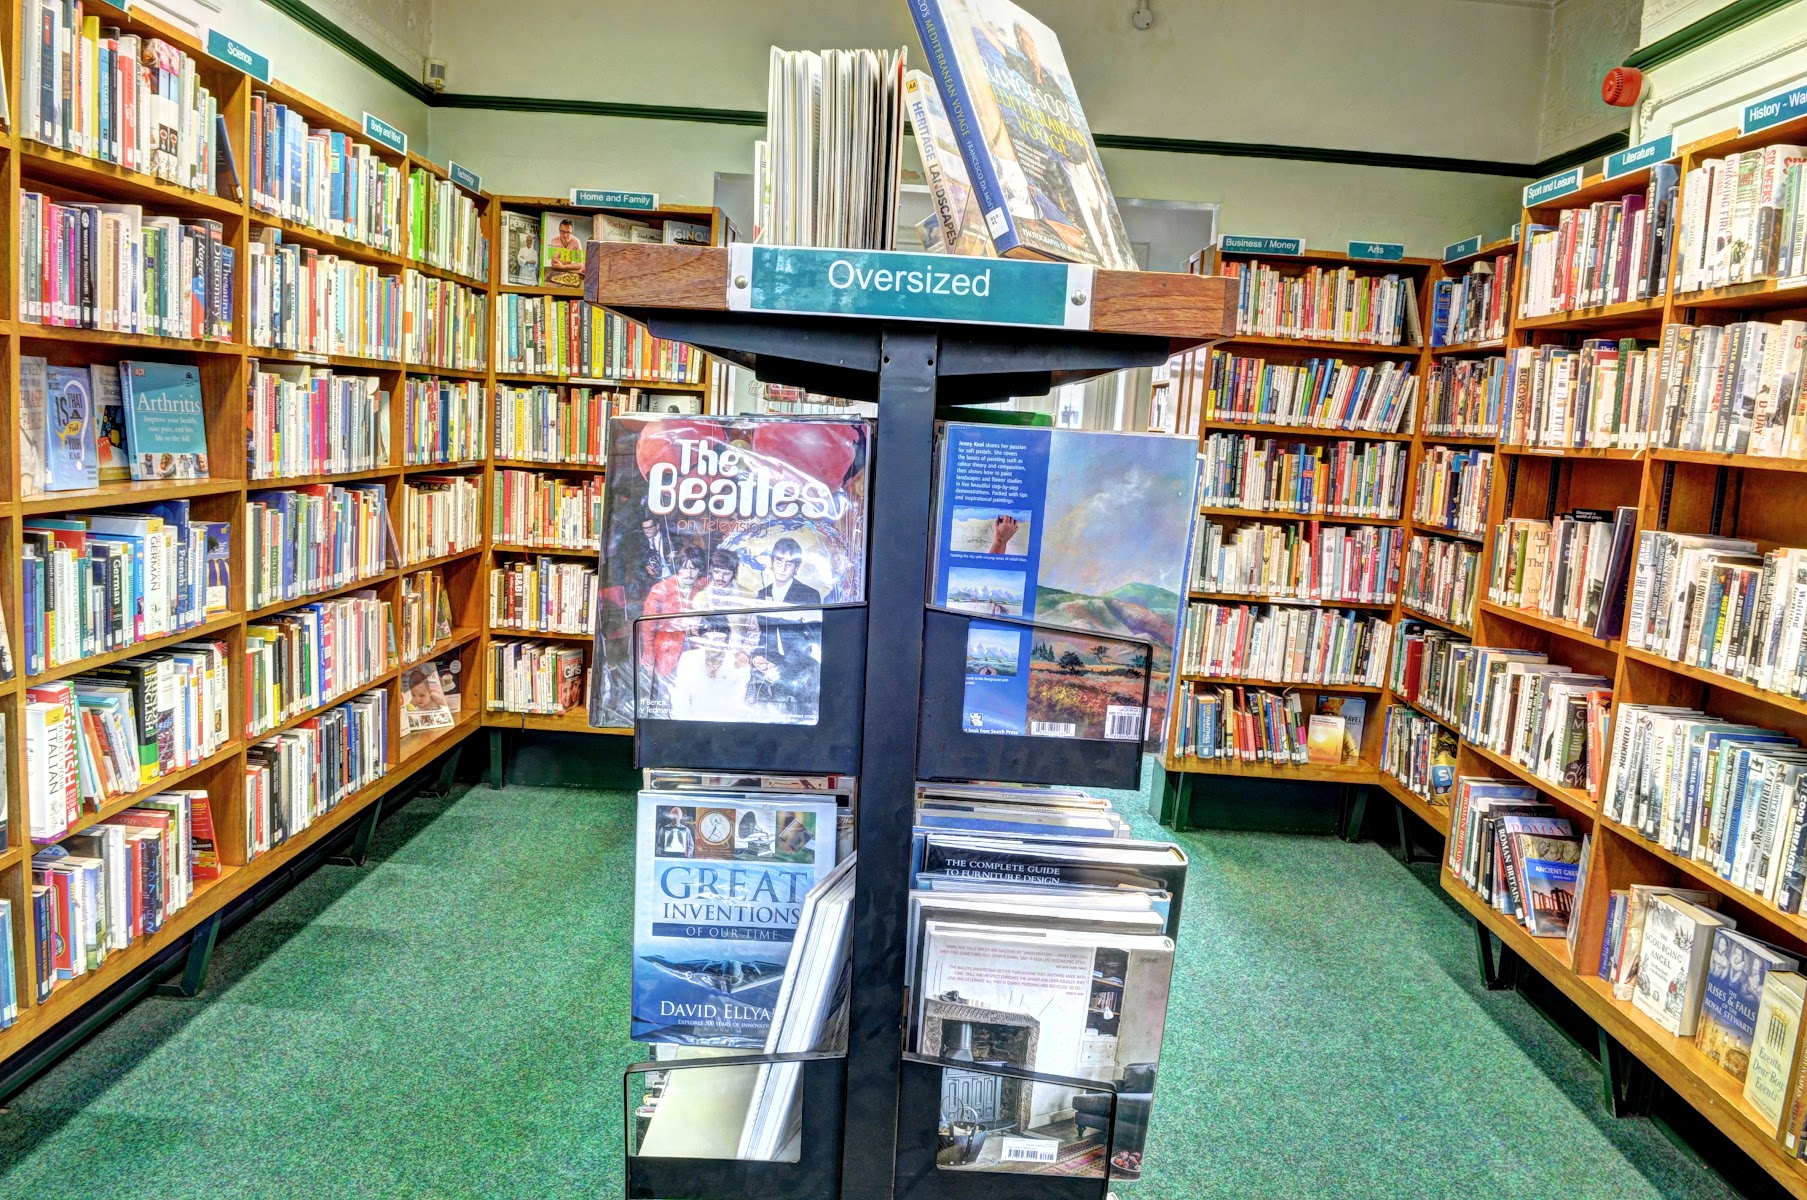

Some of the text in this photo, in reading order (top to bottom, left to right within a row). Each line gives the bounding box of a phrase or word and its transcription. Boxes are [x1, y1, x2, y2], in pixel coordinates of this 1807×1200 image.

[227, 42, 252, 65] Science
[908, 82, 917, 91] AA
[925, 19, 957, 98] MEDITERRANEAN
[952, 98, 970, 137] VOYAGE
[966, 140, 984, 184] FRANCESCO
[983, 191, 994, 211] MOST
[1750, 102, 1781, 122] History
[371, 120, 383, 135] Body
[383, 127, 392, 137] and
[1017, 116, 1070, 157] VOYAGE
[1622, 146, 1655, 166] Literature
[912, 101, 957, 246] HERITAGE LANDSCAPES
[1528, 174, 1575, 199] Sport and Leisure
[1762, 150, 1776, 204] SIX WEEKS
[580, 192, 650, 205] Home and Family
[1647, 182, 1656, 224] speeches
[1718, 160, 1734, 232] DRAWING FIRE
[1226, 238, 1262, 248] Business
[1270, 240, 1296, 251] Money
[1368, 246, 1384, 254] Arts
[212, 241, 221, 319] Dictionary
[222, 260, 232, 320] Thesaurus
[829, 259, 991, 298] Oversized
[1723, 332, 1739, 405] BATTLE OF BRITAIN
[56, 396, 69, 426] IS
[68, 393, 83, 409] THAT
[138, 392, 201, 413] Arthritis
[68, 437, 81, 450] YOUR
[674, 439, 739, 476] The
[648, 462, 832, 519] Beatles
[677, 519, 695, 531] on
[178, 549, 186, 586] French
[113, 559, 121, 605] German
[1696, 581, 1708, 602] LONG
[1632, 590, 1645, 620] RETREAT
[1716, 595, 1728, 641] MOST SECRET
[563, 664, 581, 678] Girls
[48, 727, 58, 794] ITALIAN
[1619, 726, 1630, 769] DUNKIRK
[1653, 736, 1664, 779] INFERNO
[1690, 757, 1698, 781] SPECIAL
[1706, 755, 1715, 783] BOMBER
[1685, 796, 1694, 824] BOMBER
[1753, 777, 1773, 848] TERROR SKY
[1763, 784, 1782, 852] MONTY'S MARAUDERS
[1785, 795, 1807, 877] CODE BREAKERS
[945, 868, 957, 876] TO
[946, 858, 1060, 875] THE COMPLETE GUIDE
[1498, 828, 1520, 903] ROMAN BRITAIN
[1536, 866, 1562, 875] ANCIENT
[660, 865, 808, 903] GREAT
[663, 902, 800, 924] INVENTIONS
[686, 926, 778, 940] OF OUR TIME
[1651, 951, 1672, 969] ANGEL
[1708, 983, 1726, 1001] RISES
[1736, 1001, 1756, 1022] FALLS
[1728, 990, 1737, 999] THE
[660, 1000, 717, 1018] DAVID
[1704, 998, 1753, 1036] ROYAL STEWARTS
[1728, 1006, 1737, 1016] THE
[1753, 1060, 1770, 1076] Dear
[1755, 1077, 1777, 1101] Events
